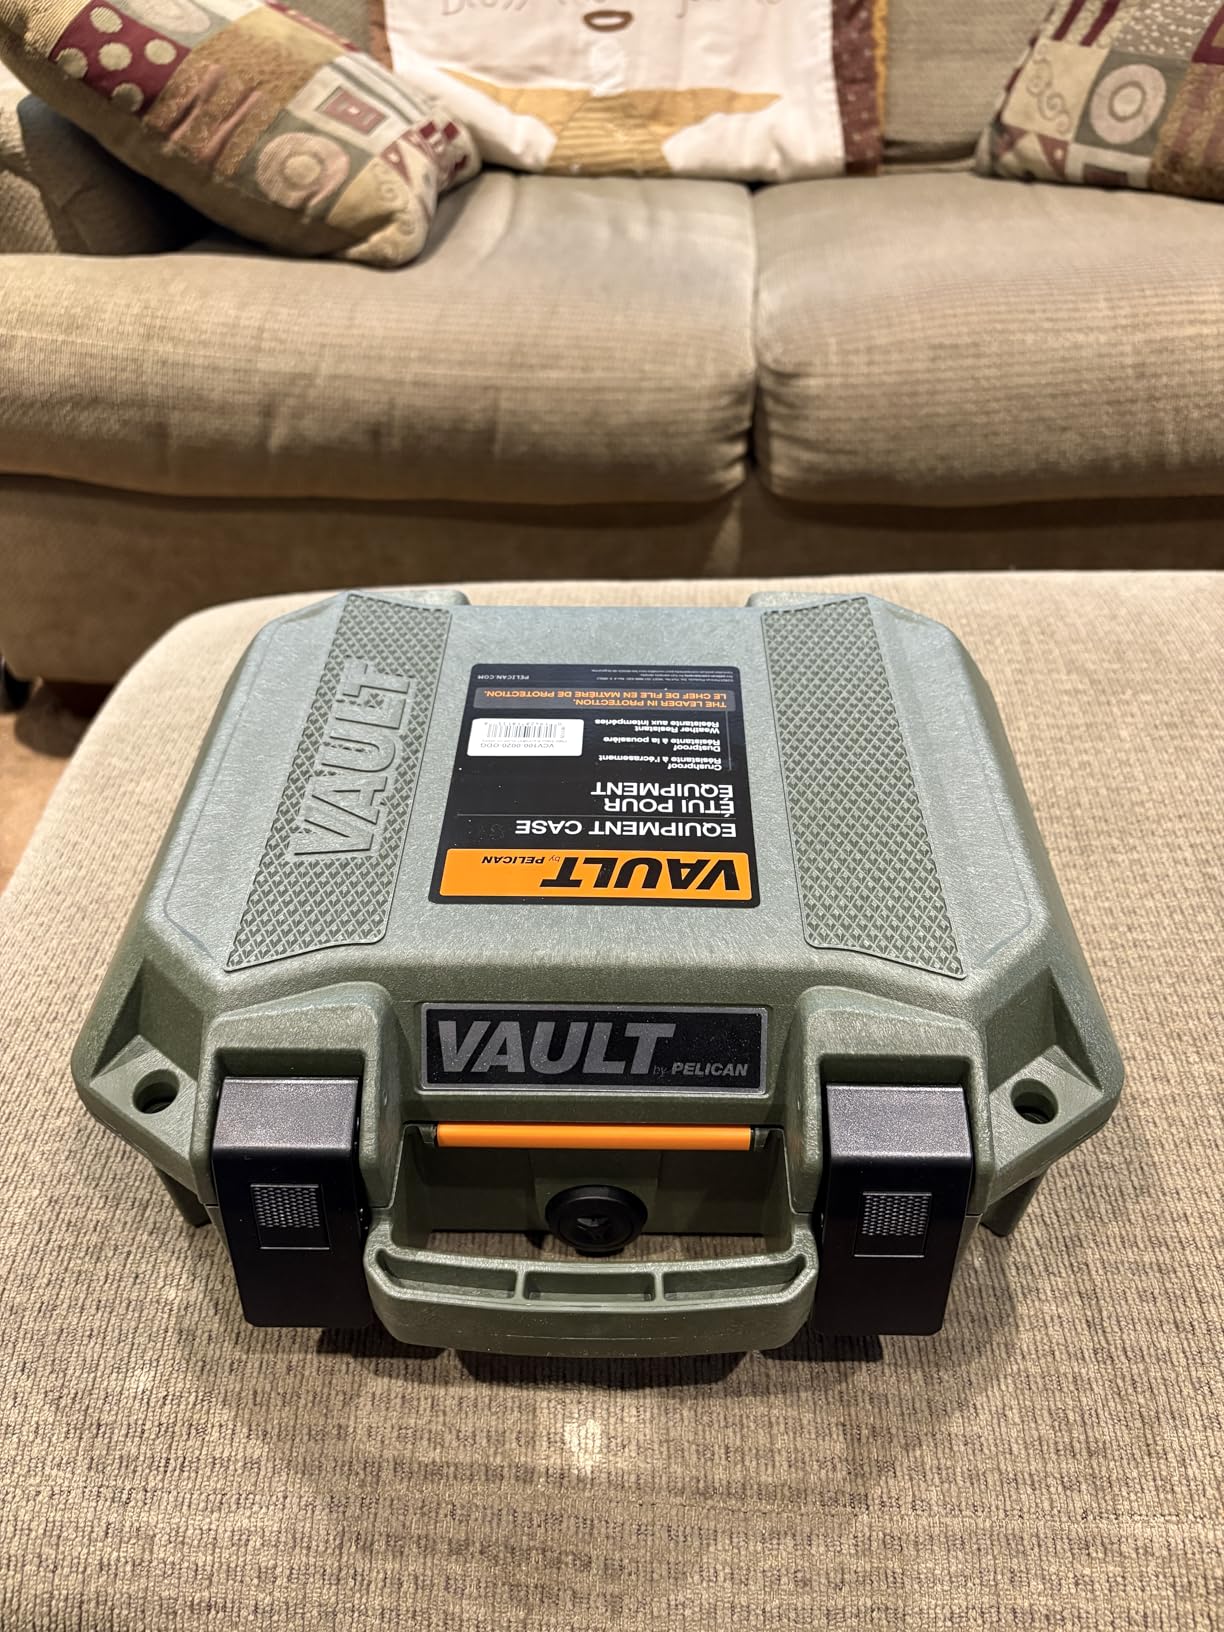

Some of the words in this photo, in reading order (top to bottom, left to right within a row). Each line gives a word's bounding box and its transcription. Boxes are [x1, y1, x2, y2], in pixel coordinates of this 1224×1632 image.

[575, 691, 620, 699] MATIÈRE
[286, 655, 411, 856] VAULT
[591, 782, 733, 799] ÉQUIPMENT
[605, 798, 672, 813] POUR
[682, 799, 734, 817] ÉTUI
[515, 820, 582, 834] CASE
[589, 820, 736, 837] EQUIPMENT
[482, 856, 545, 864] PELICAN
[540, 856, 740, 891] VAULT
[438, 1020, 676, 1075] VAULT
[653, 1065, 668, 1077] by
[671, 1062, 748, 1077] PELICAN
